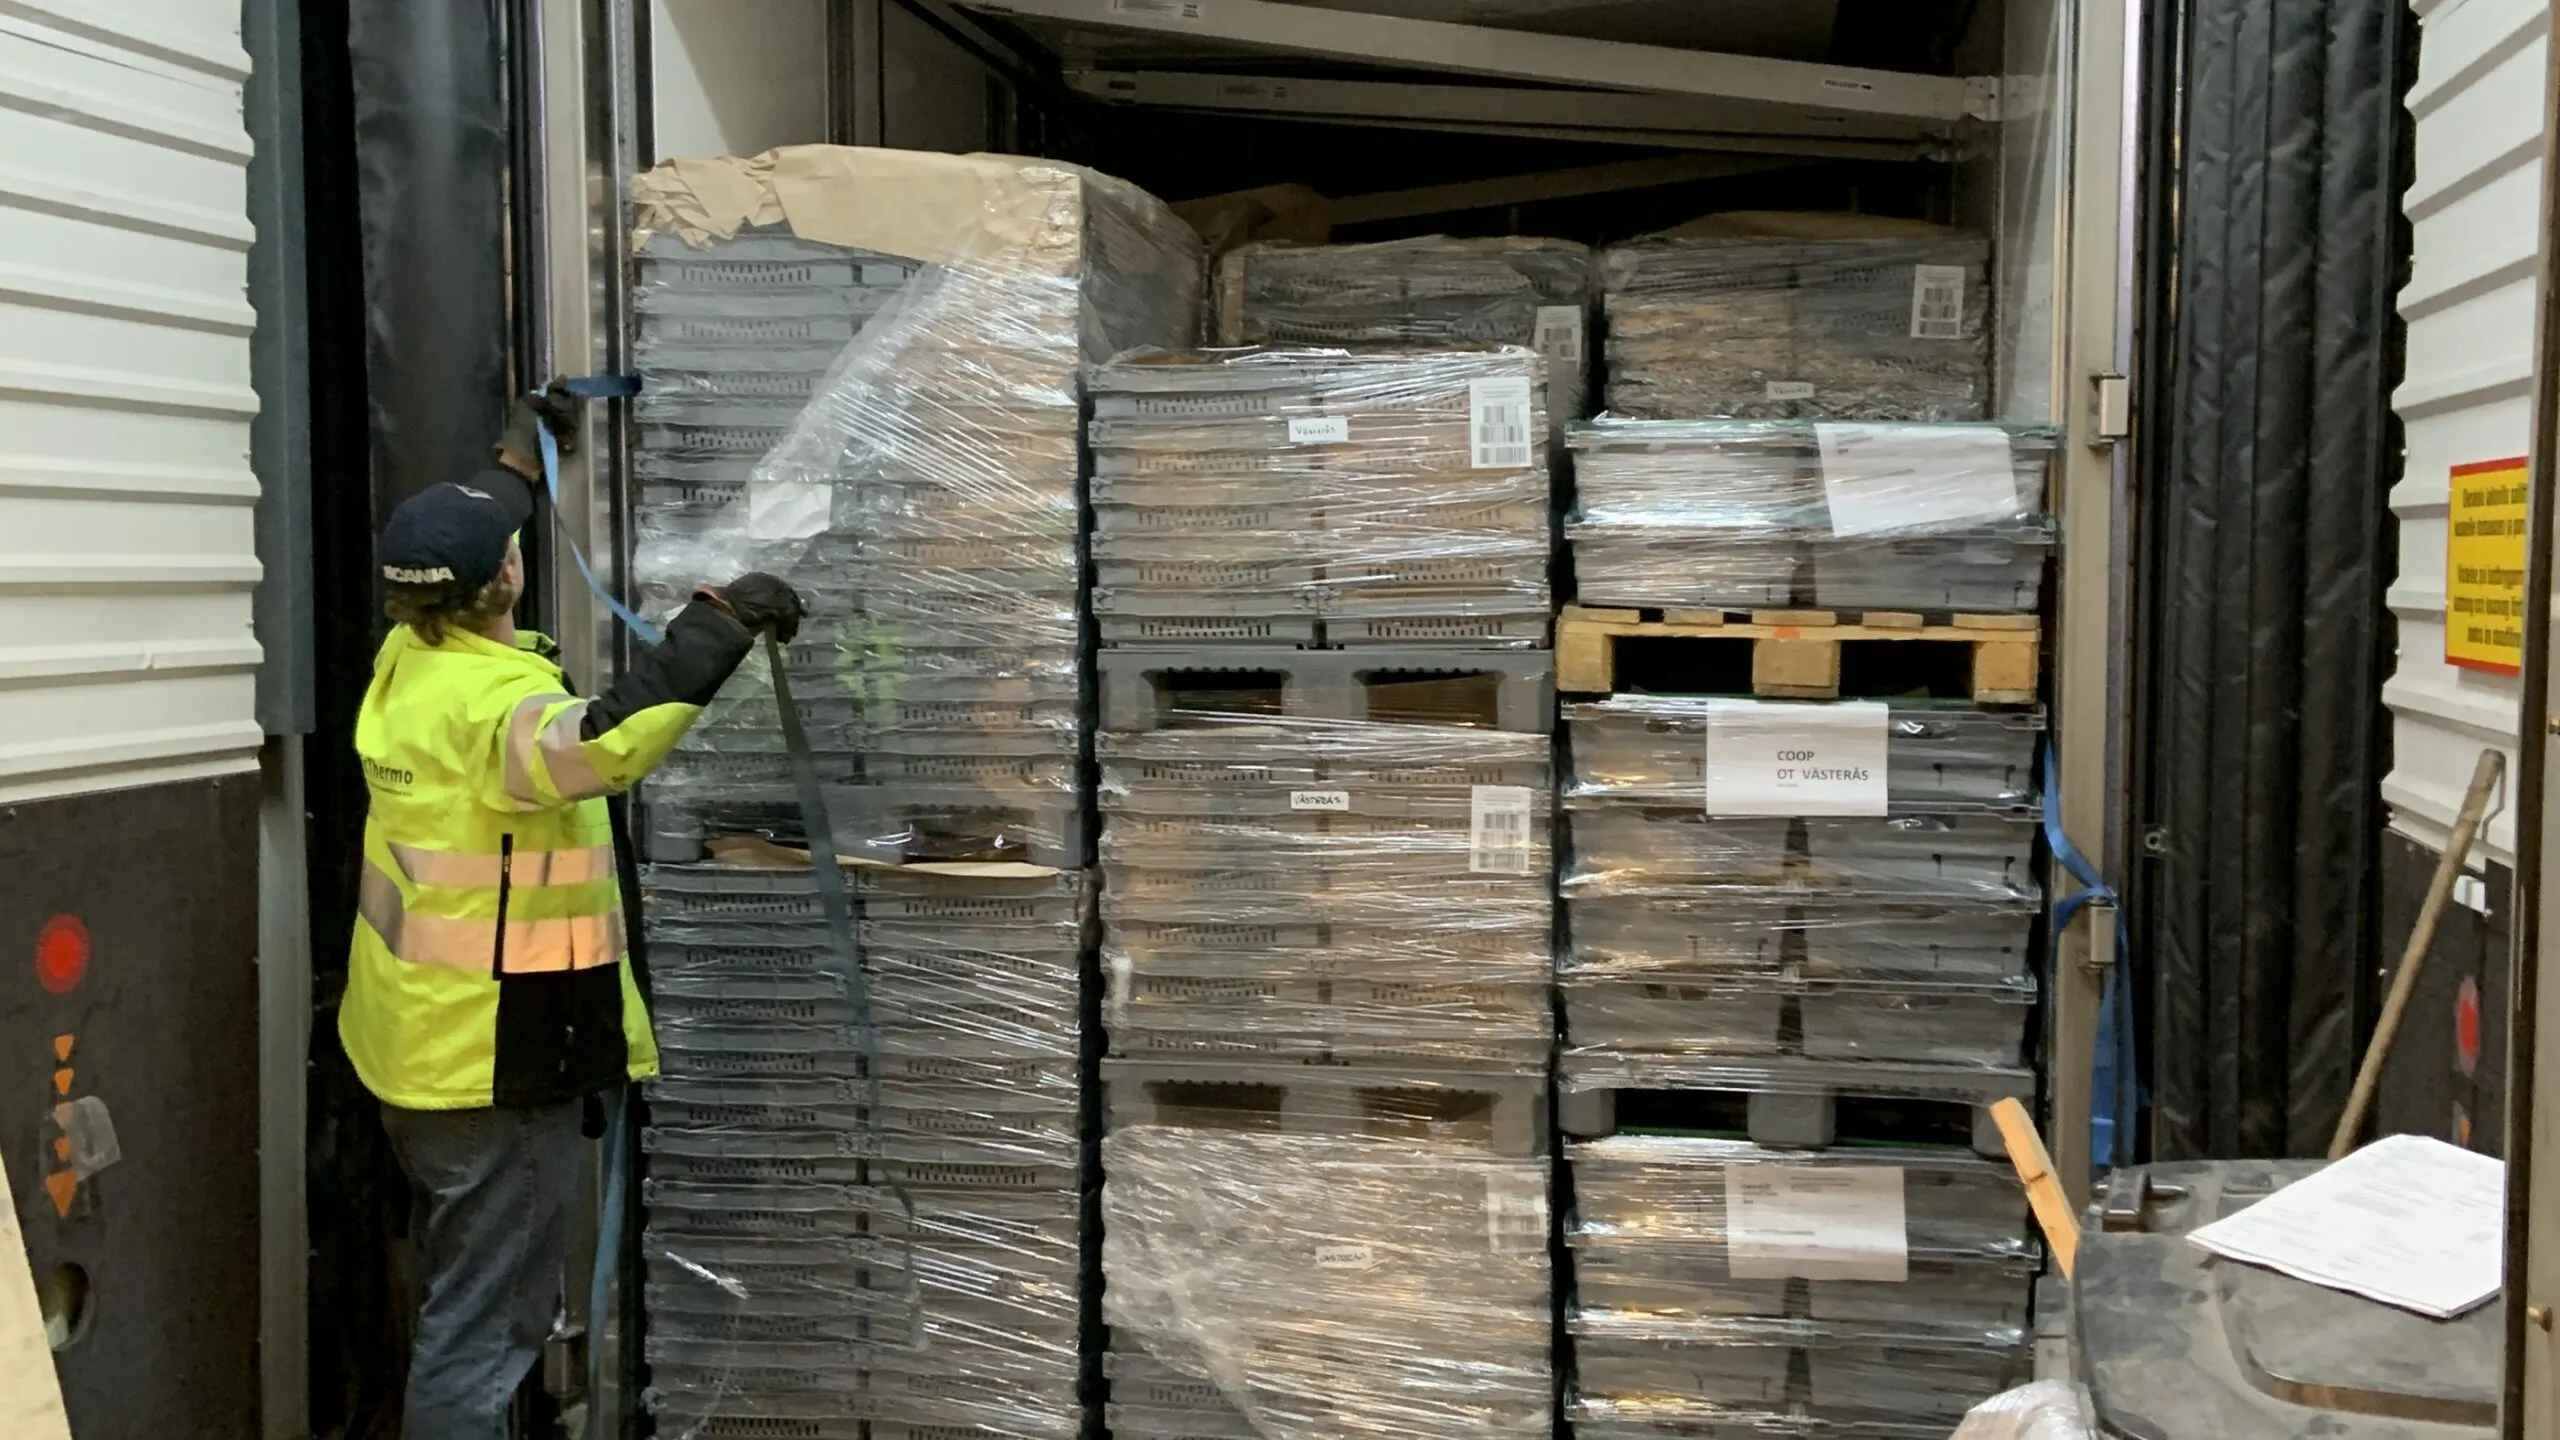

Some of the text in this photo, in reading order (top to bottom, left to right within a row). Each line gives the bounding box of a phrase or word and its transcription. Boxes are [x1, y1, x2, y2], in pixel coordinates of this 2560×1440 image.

[383, 565, 455, 584] SCANIA
[1776, 750, 1815, 762] COOP
[1776, 766, 1869, 781] OT VÄSTERÅS
